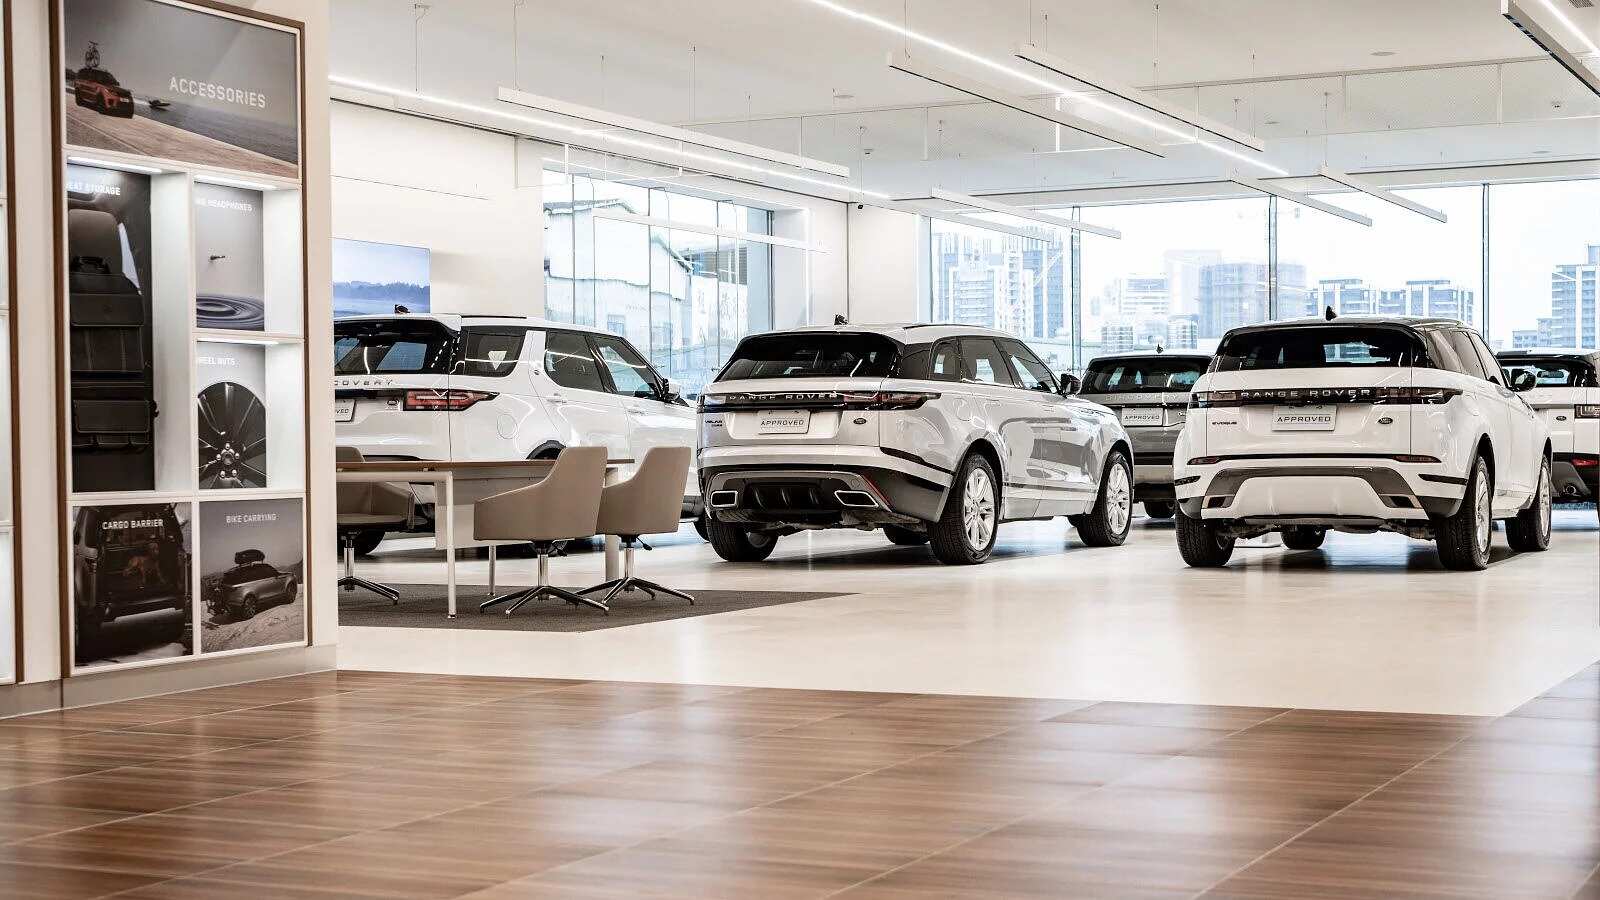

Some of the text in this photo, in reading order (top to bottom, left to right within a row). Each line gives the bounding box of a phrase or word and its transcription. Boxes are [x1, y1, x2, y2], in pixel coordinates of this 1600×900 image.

[169, 76, 266, 109] ACCESSORIES
[1240, 389, 1371, 398] RANGE ROVER
[760, 419, 805, 427] APPROVED
[101, 518, 164, 530] CARGO BARRIER
[225, 513, 277, 524] BIKE CARRYING
